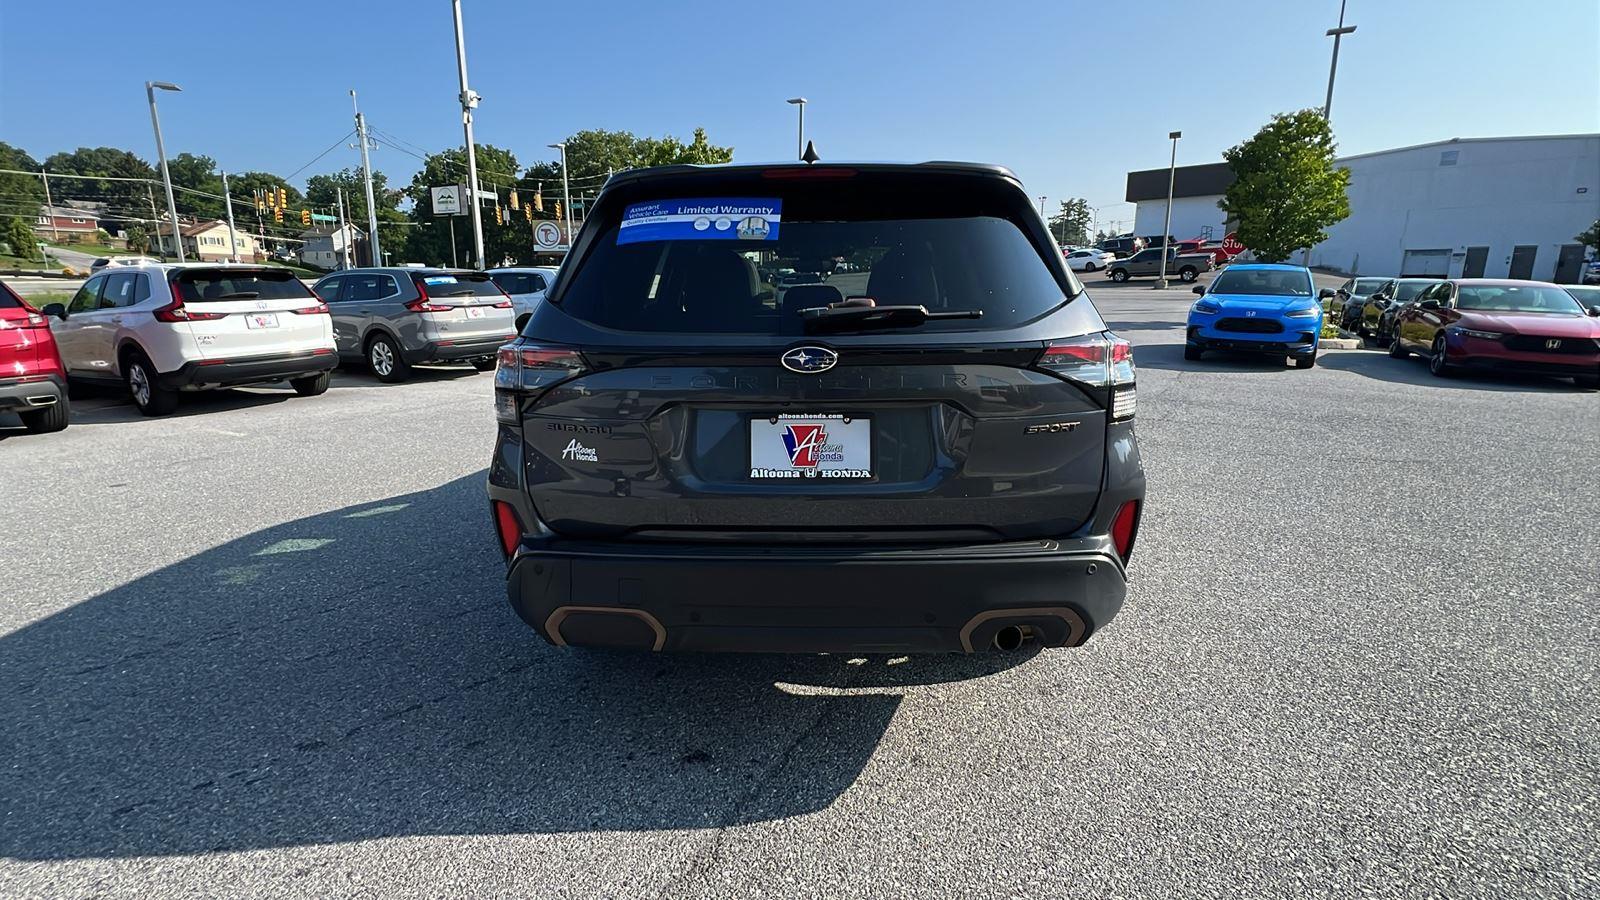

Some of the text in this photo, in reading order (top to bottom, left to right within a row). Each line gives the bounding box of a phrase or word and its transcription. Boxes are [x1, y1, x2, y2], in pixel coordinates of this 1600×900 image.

[629, 204, 660, 213] Assurant
[677, 205, 774, 216] Limited Warranty
[545, 422, 614, 434] SUBARU
[1024, 421, 1080, 434] SPORT
[562, 438, 596, 460] Altoona
[792, 428, 843, 461] Altoona
[576, 453, 598, 462] Honda
[812, 452, 843, 461] Honda
[750, 467, 871, 478] Altoona HONDA
